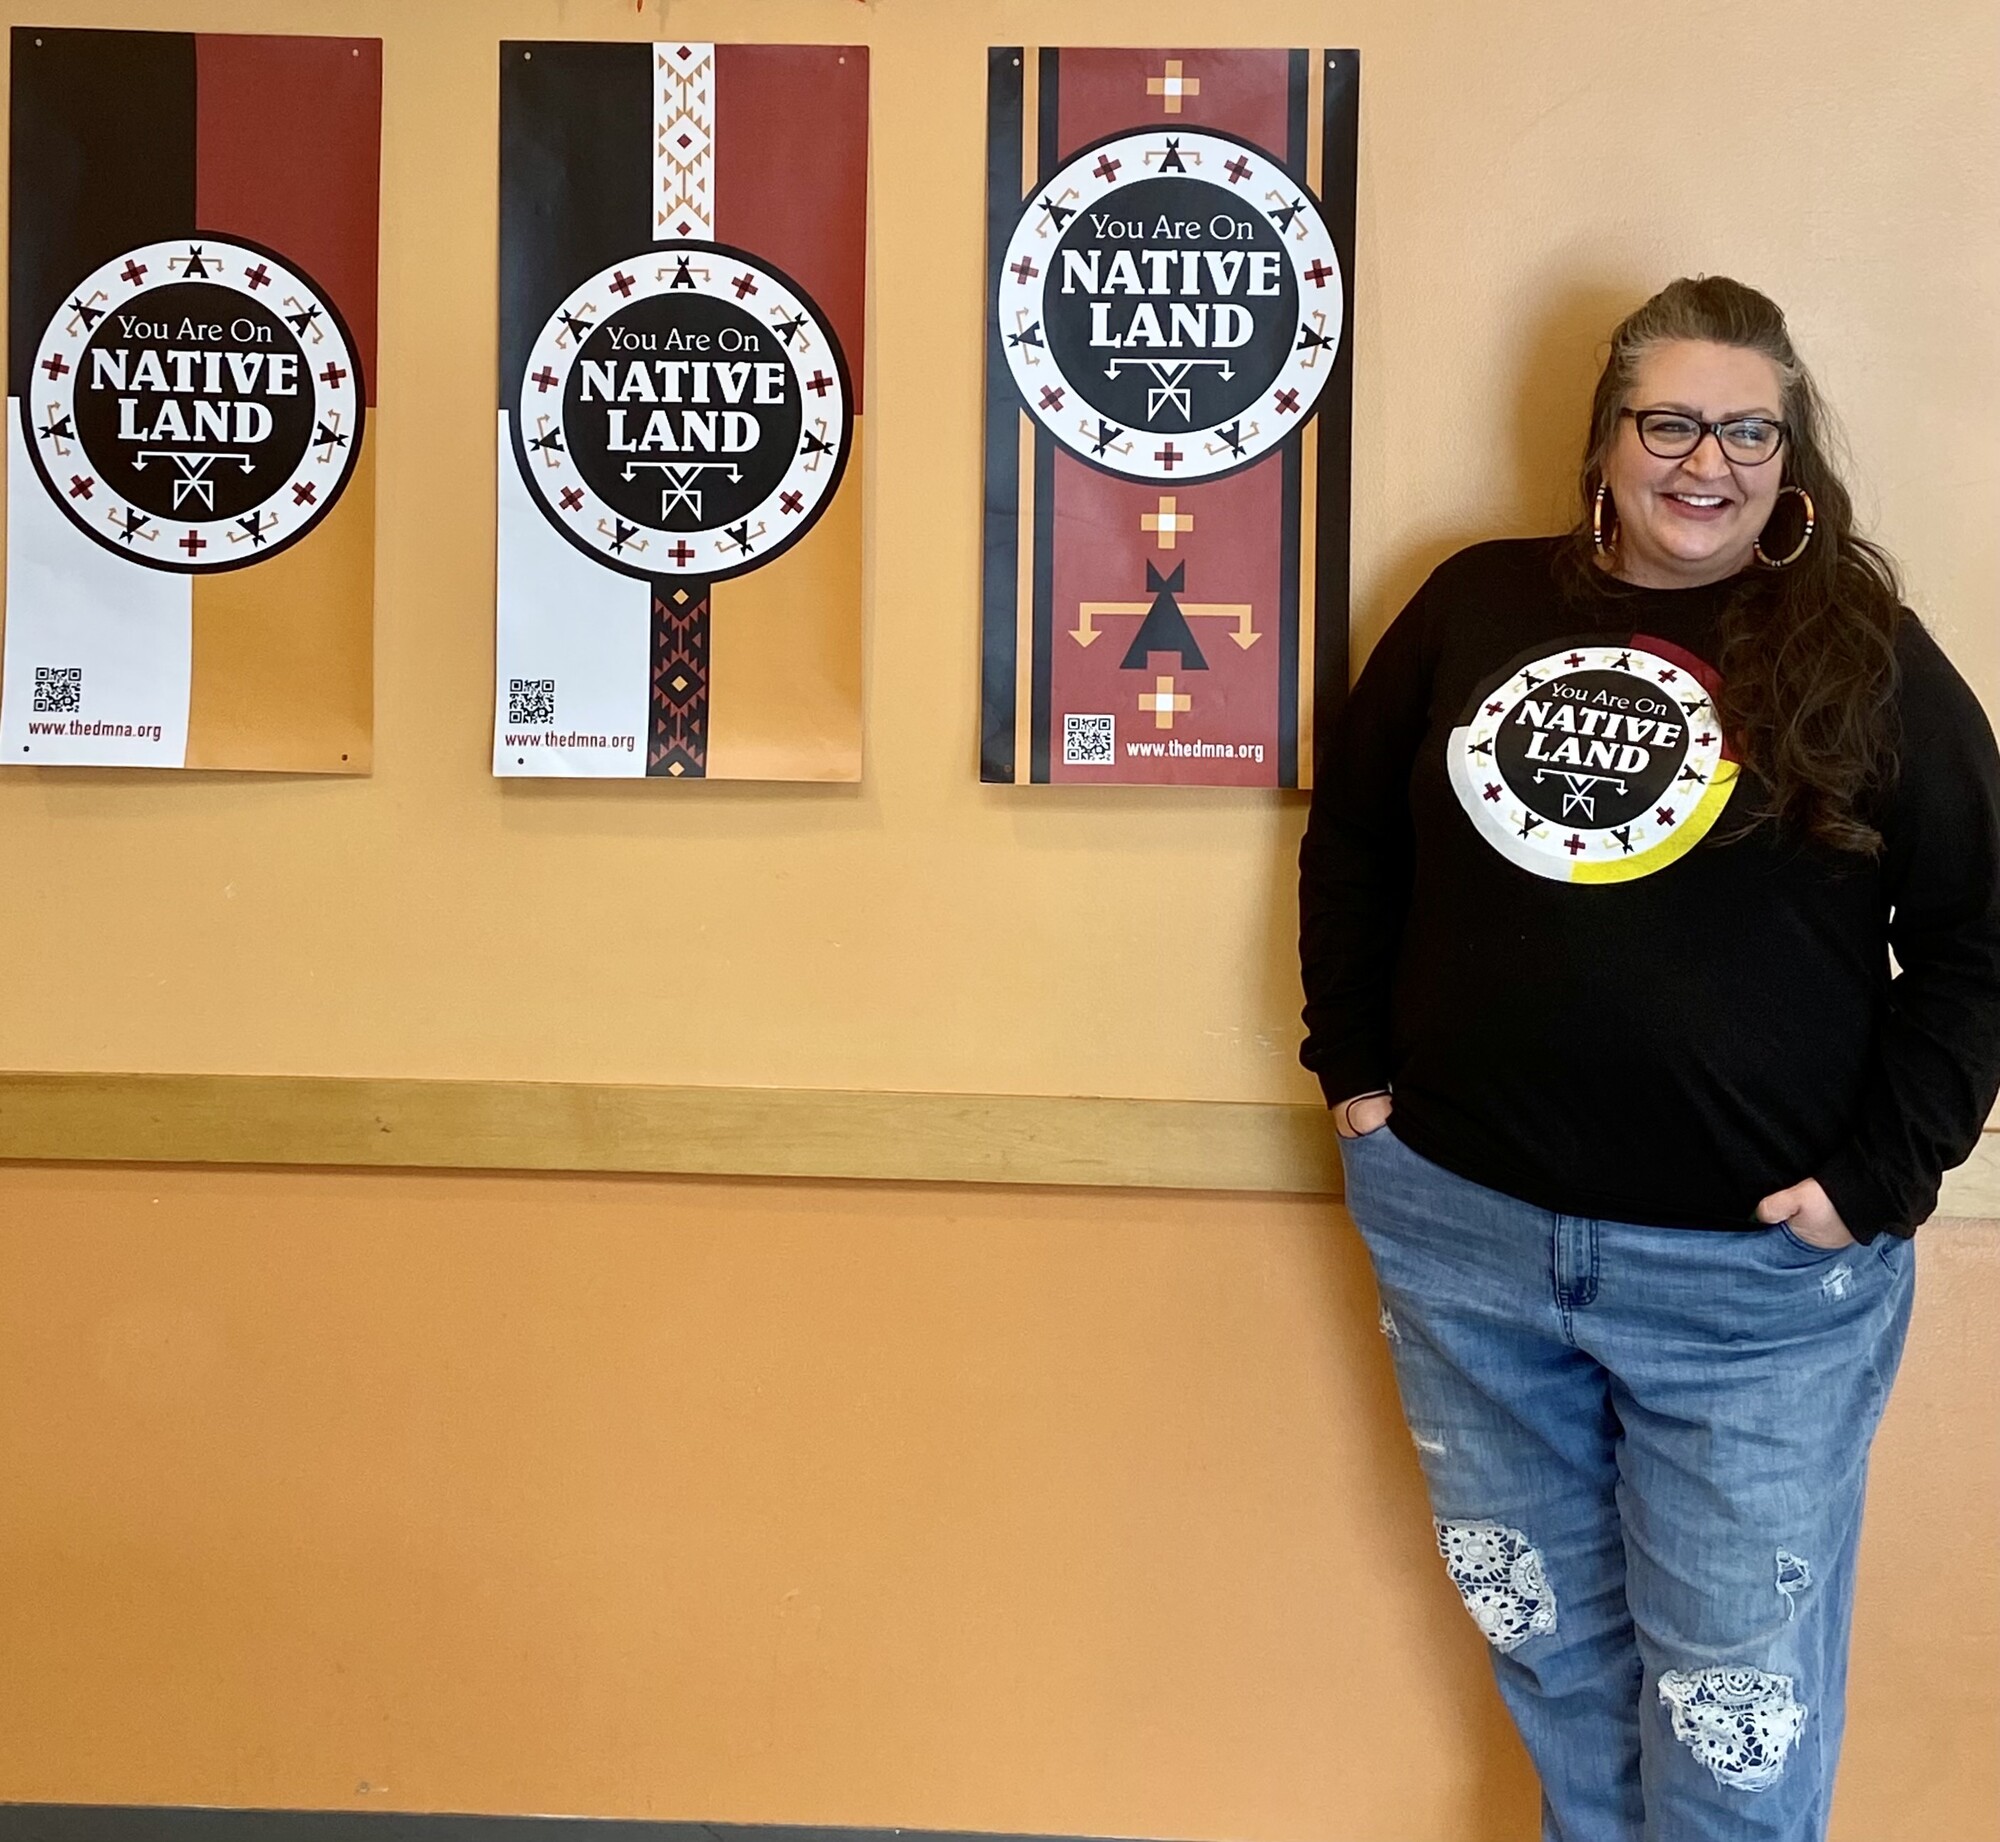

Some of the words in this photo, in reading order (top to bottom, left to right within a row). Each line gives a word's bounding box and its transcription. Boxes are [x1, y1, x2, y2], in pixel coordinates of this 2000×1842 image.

[1089, 213, 1144, 239] You
[1151, 214, 1201, 240] Are
[1209, 214, 1254, 240] On
[1061, 249, 1281, 296] NATIVE
[117, 315, 169, 340] You
[176, 317, 223, 341] Are
[230, 318, 273, 343] On
[606, 326, 658, 350] You
[664, 327, 711, 351] Are
[718, 328, 760, 352] On
[1089, 302, 1255, 349] LAND
[90, 348, 298, 396] NATIVE
[579, 360, 785, 404] NATIVE
[117, 398, 273, 444] LAND
[606, 409, 761, 453] LAND
[1551, 682, 1590, 702] You
[1592, 688, 1630, 710] Are
[1634, 697, 1668, 717] On
[29, 719, 162, 742] www.thedmna.org
[505, 731, 636, 752] www.thedmna.org
[1515, 700, 1683, 748] NATIVE
[1126, 739, 1264, 762] www.thedmna.org
[1524, 731, 1650, 774] LAND
